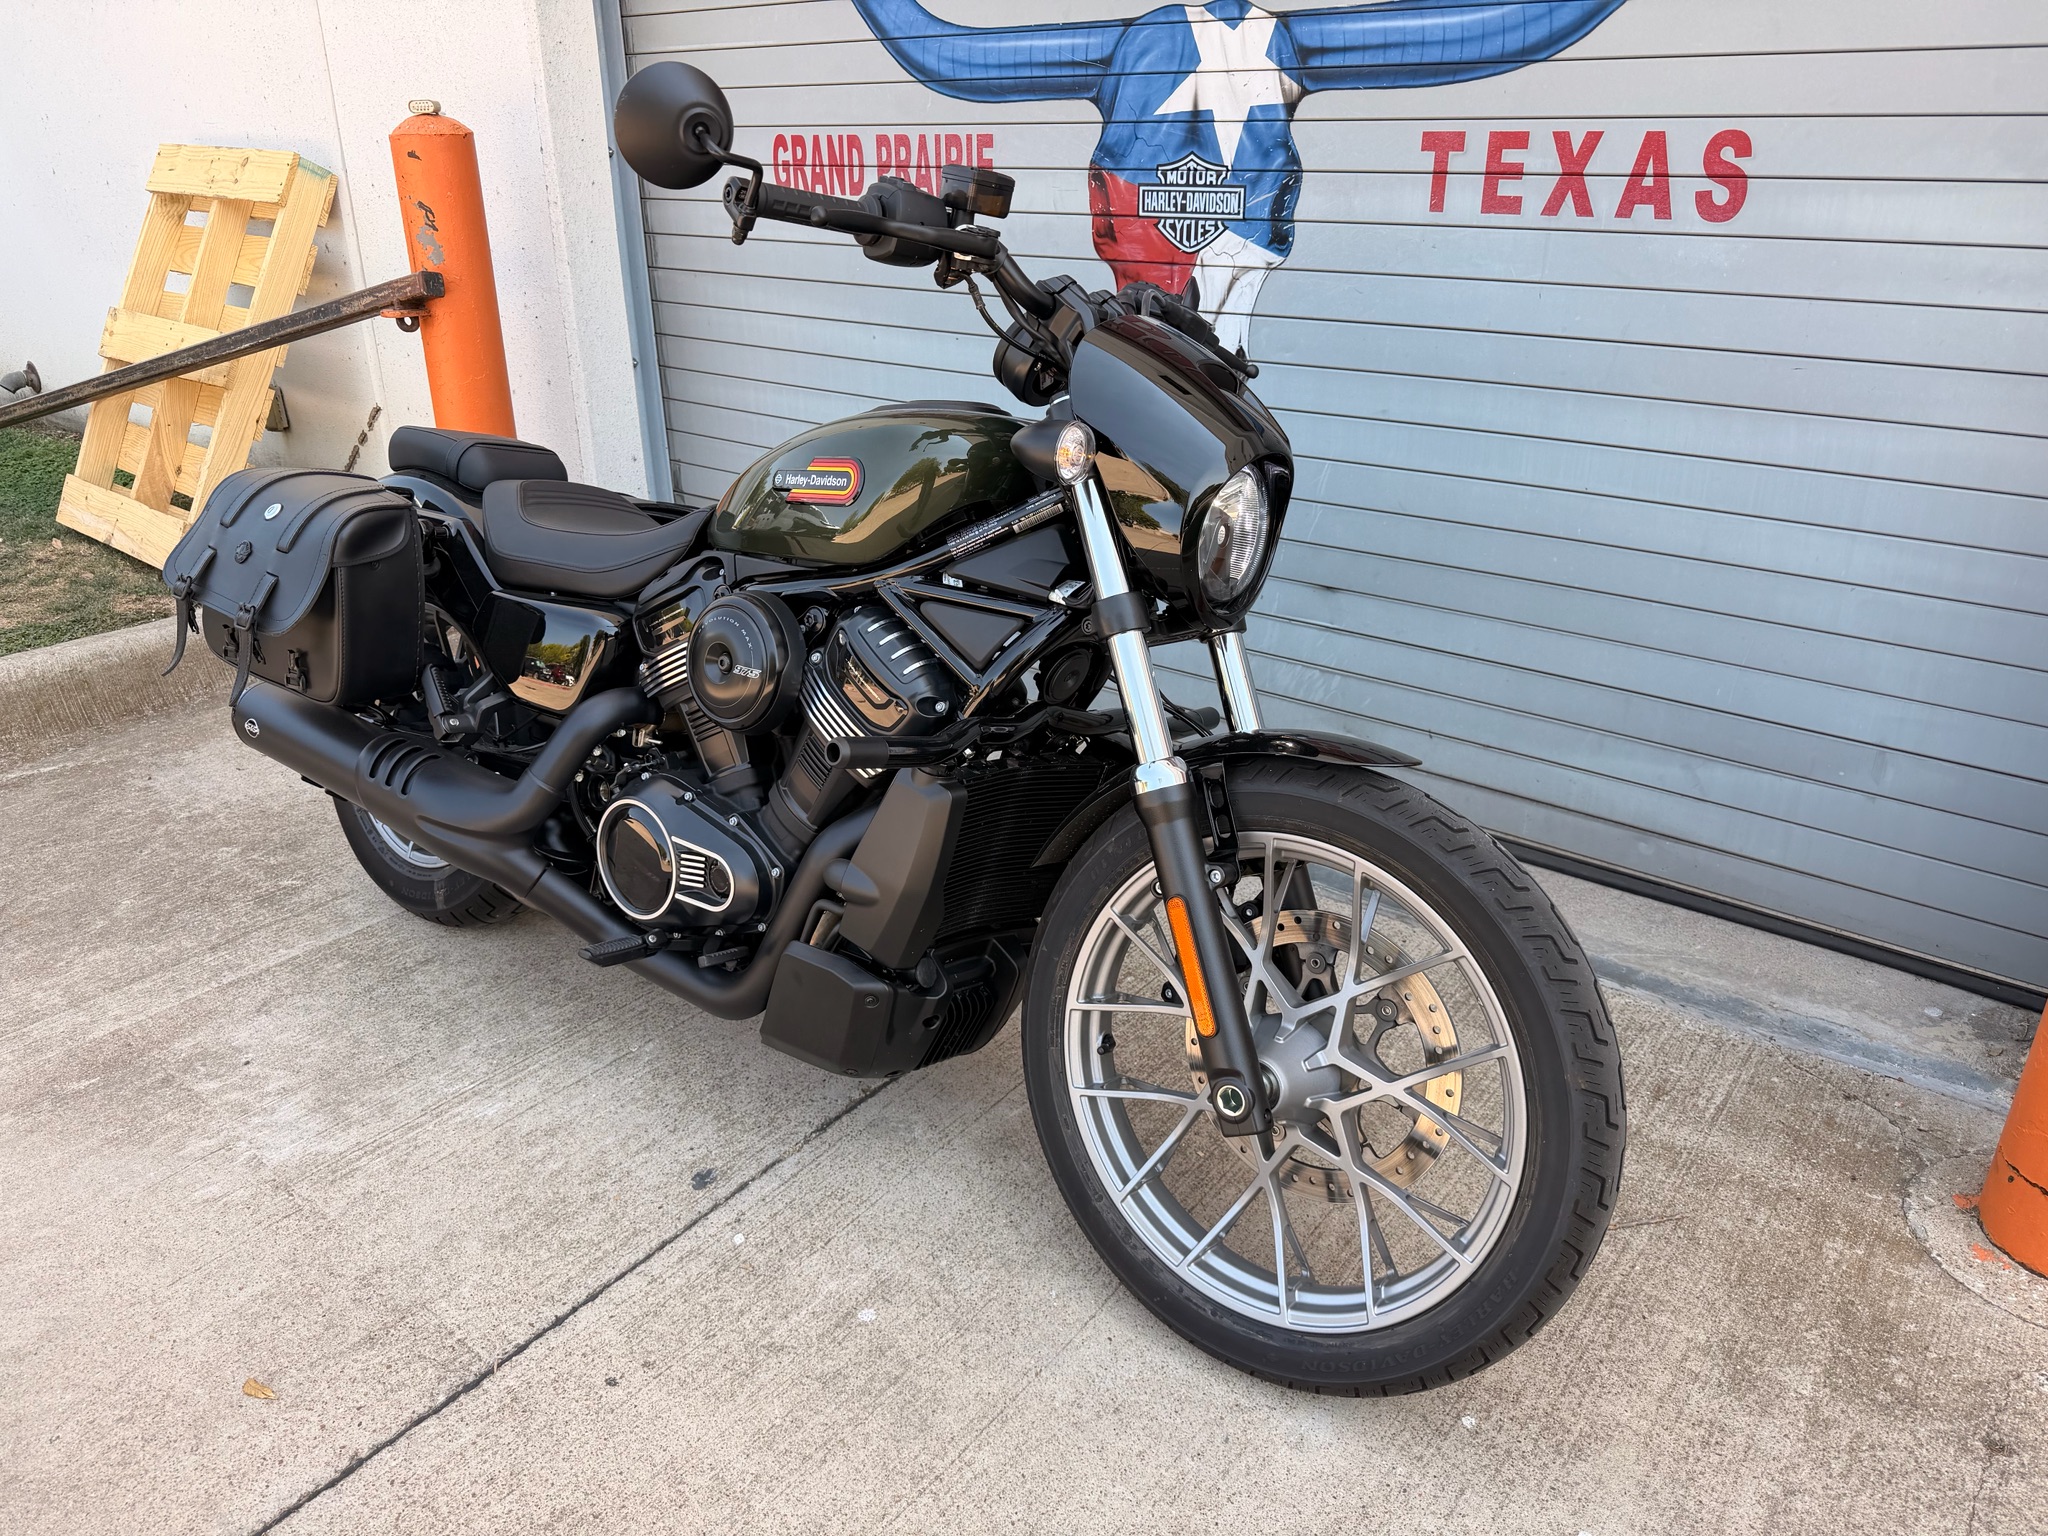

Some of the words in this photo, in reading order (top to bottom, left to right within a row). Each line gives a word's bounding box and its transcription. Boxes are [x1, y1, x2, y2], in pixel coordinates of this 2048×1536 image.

[773, 133, 865, 197] GRAND
[1166, 160, 1217, 186] MOTOR
[1420, 129, 1754, 224] TEXAS
[1144, 190, 1240, 214] HARLEY-DAVIDSON
[1165, 219, 1216, 248] CYCLES
[785, 473, 848, 487] Harley-Davidson
